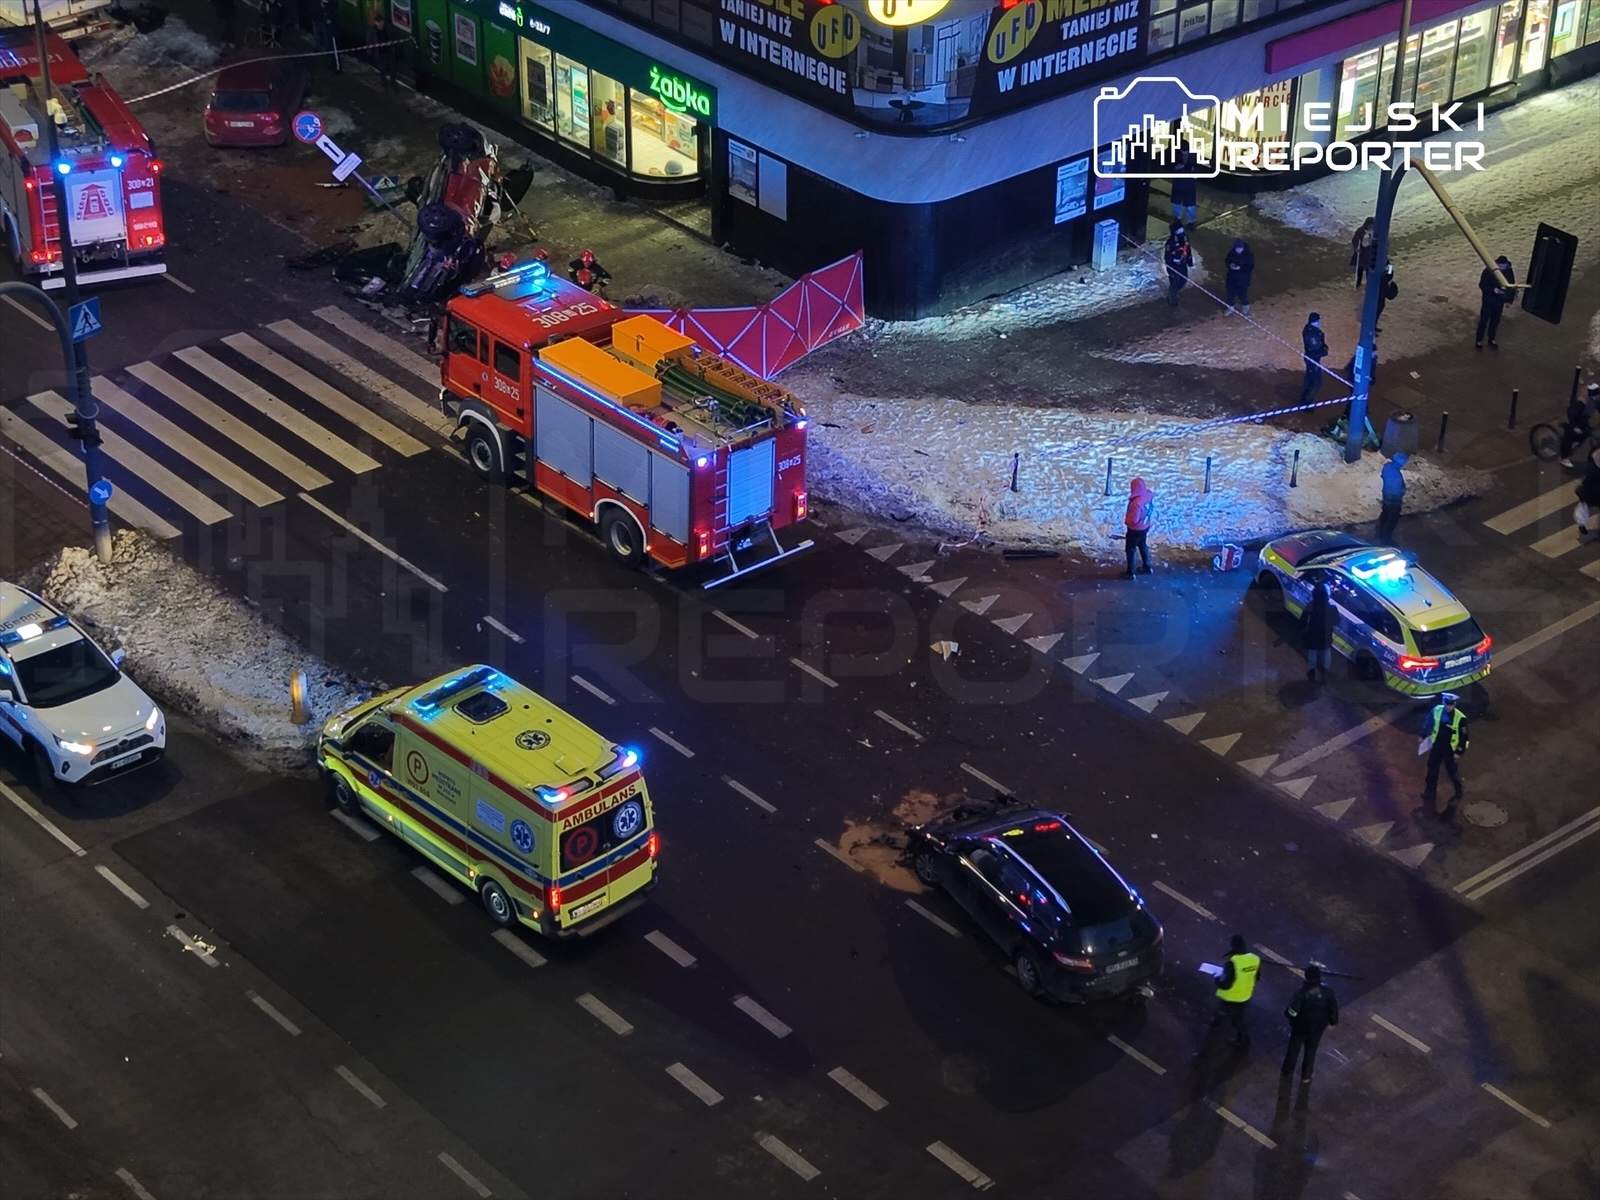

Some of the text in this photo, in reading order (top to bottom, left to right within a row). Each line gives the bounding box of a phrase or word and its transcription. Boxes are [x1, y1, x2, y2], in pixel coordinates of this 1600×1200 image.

[767, 11, 792, 38] NIŻ
[807, 13, 854, 50] UFO
[995, 3, 1036, 60] UFO
[1060, 8, 1111, 40] TANIEJ
[719, 18, 847, 95] W INTERNECIE
[998, 26, 1138, 94] W INTERNECIE
[649, 66, 713, 116] żabka
[413, 757, 422, 774] P
[563, 784, 637, 830] AMBULANS
